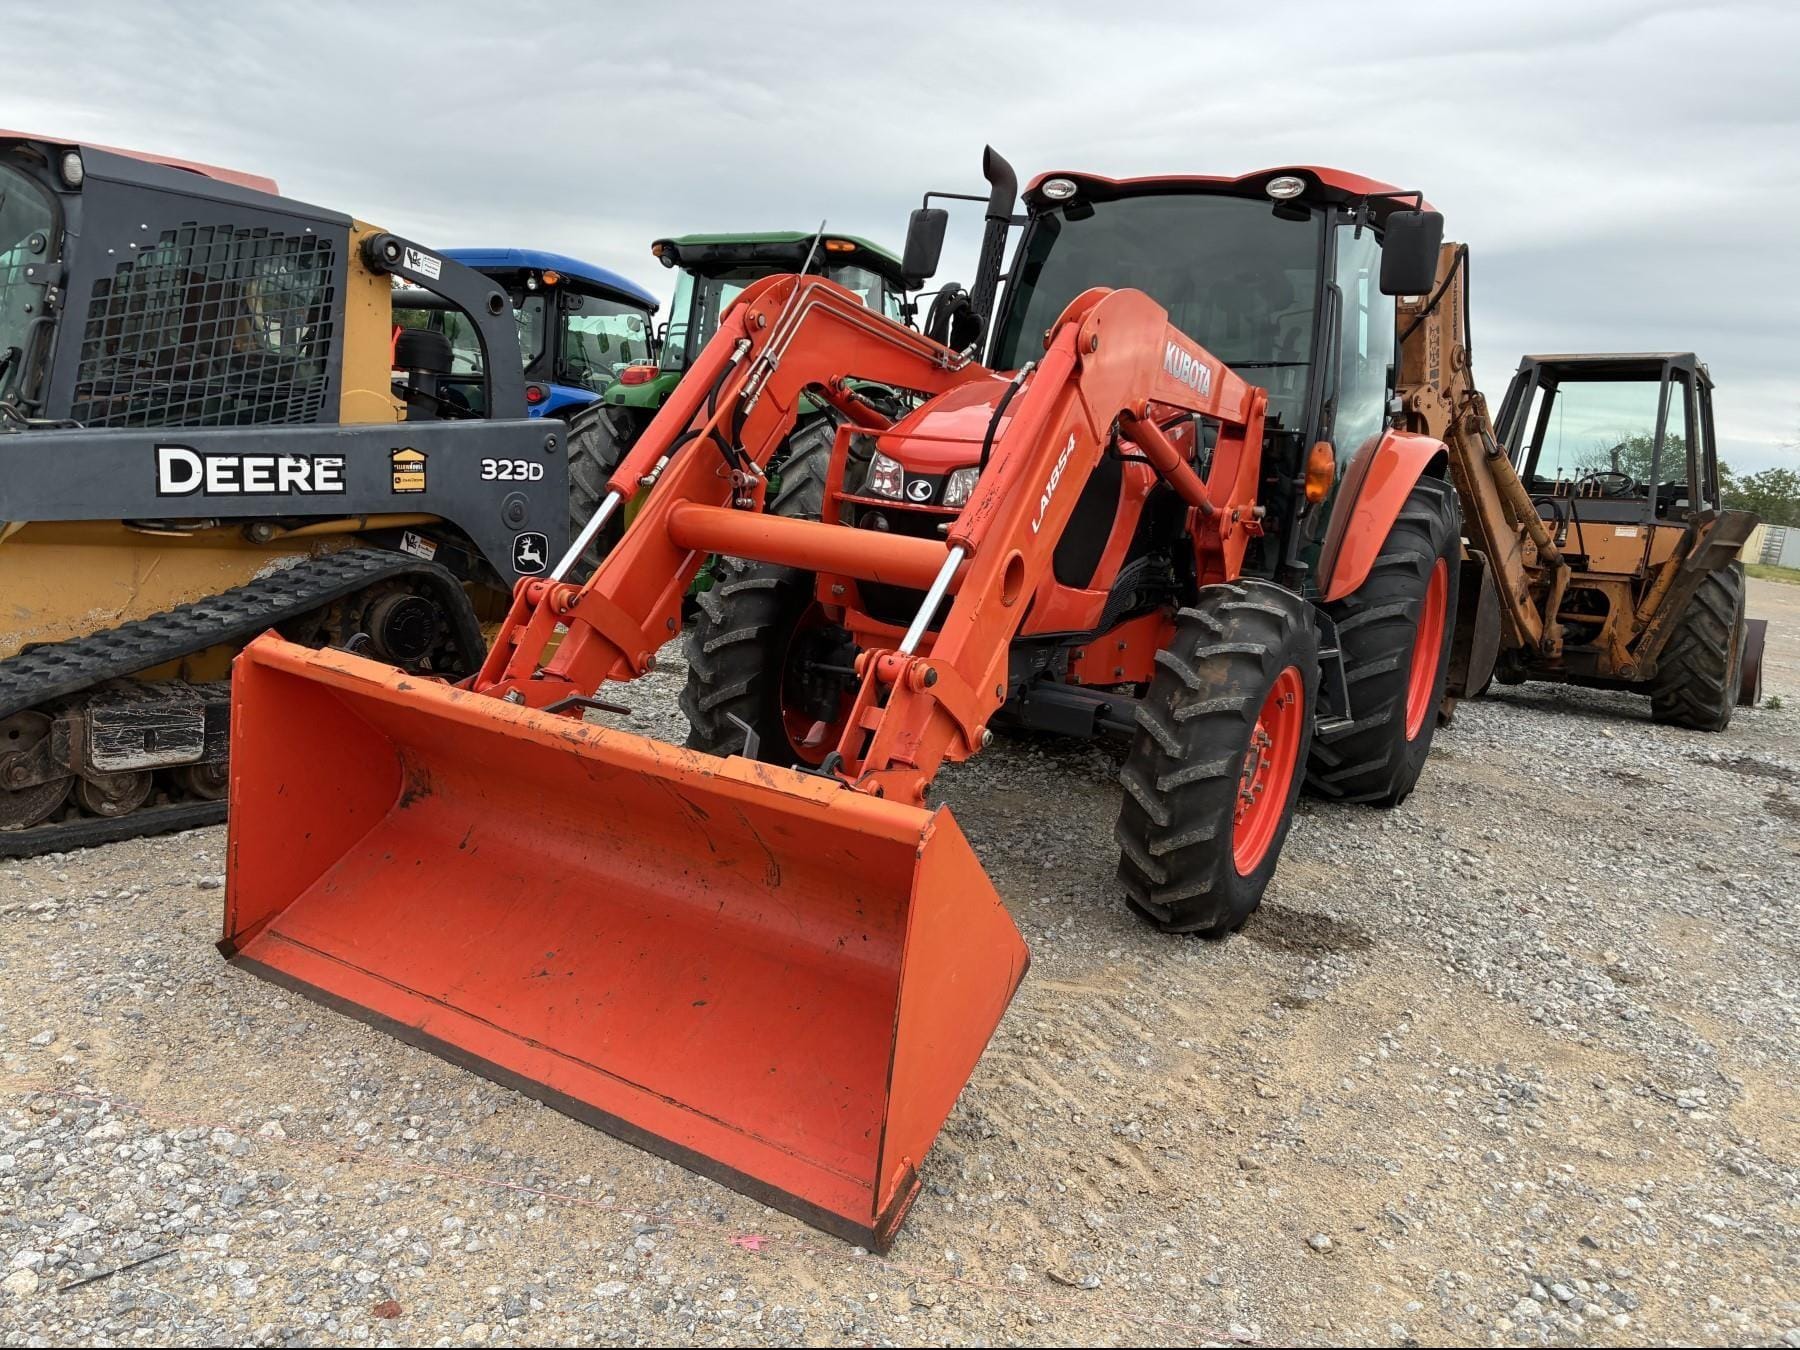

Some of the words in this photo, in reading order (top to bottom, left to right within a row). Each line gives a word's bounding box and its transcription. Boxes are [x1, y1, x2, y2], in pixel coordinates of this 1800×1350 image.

[1163, 340, 1211, 398] KUBOTA
[157, 447, 345, 494] DEERE
[481, 458, 544, 481] 323D
[1031, 432, 1076, 535] LA1854
